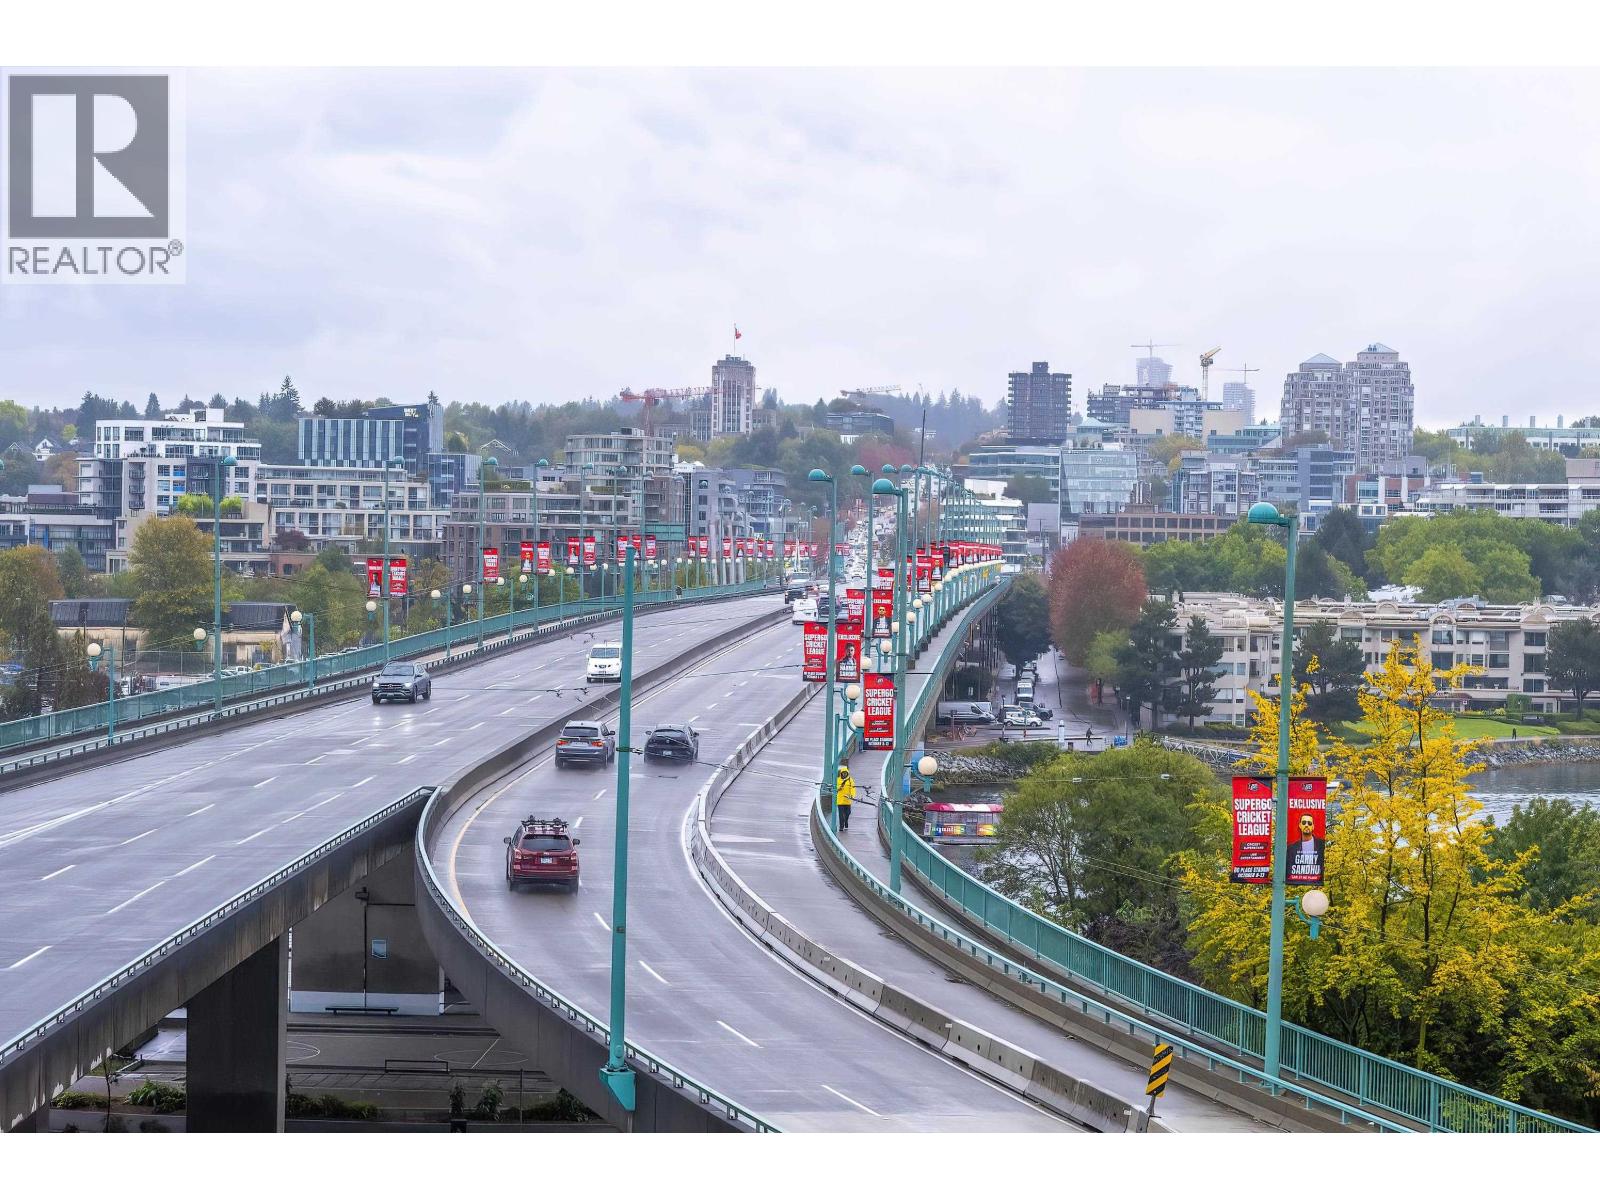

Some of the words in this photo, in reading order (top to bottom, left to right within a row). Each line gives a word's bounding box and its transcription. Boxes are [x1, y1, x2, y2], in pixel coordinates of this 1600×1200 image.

[866, 698, 893, 706] CRICKET
[867, 707, 891, 715] LEAGUE
[1234, 798, 1272, 810] SUPER60
[1289, 798, 1326, 810] EXCLUSIVE
[1236, 810, 1271, 823] CRICKET
[1238, 823, 1270, 836] LEAGUE
[1295, 854, 1318, 864] GARRY
[1291, 864, 1321, 875] SANDHU
